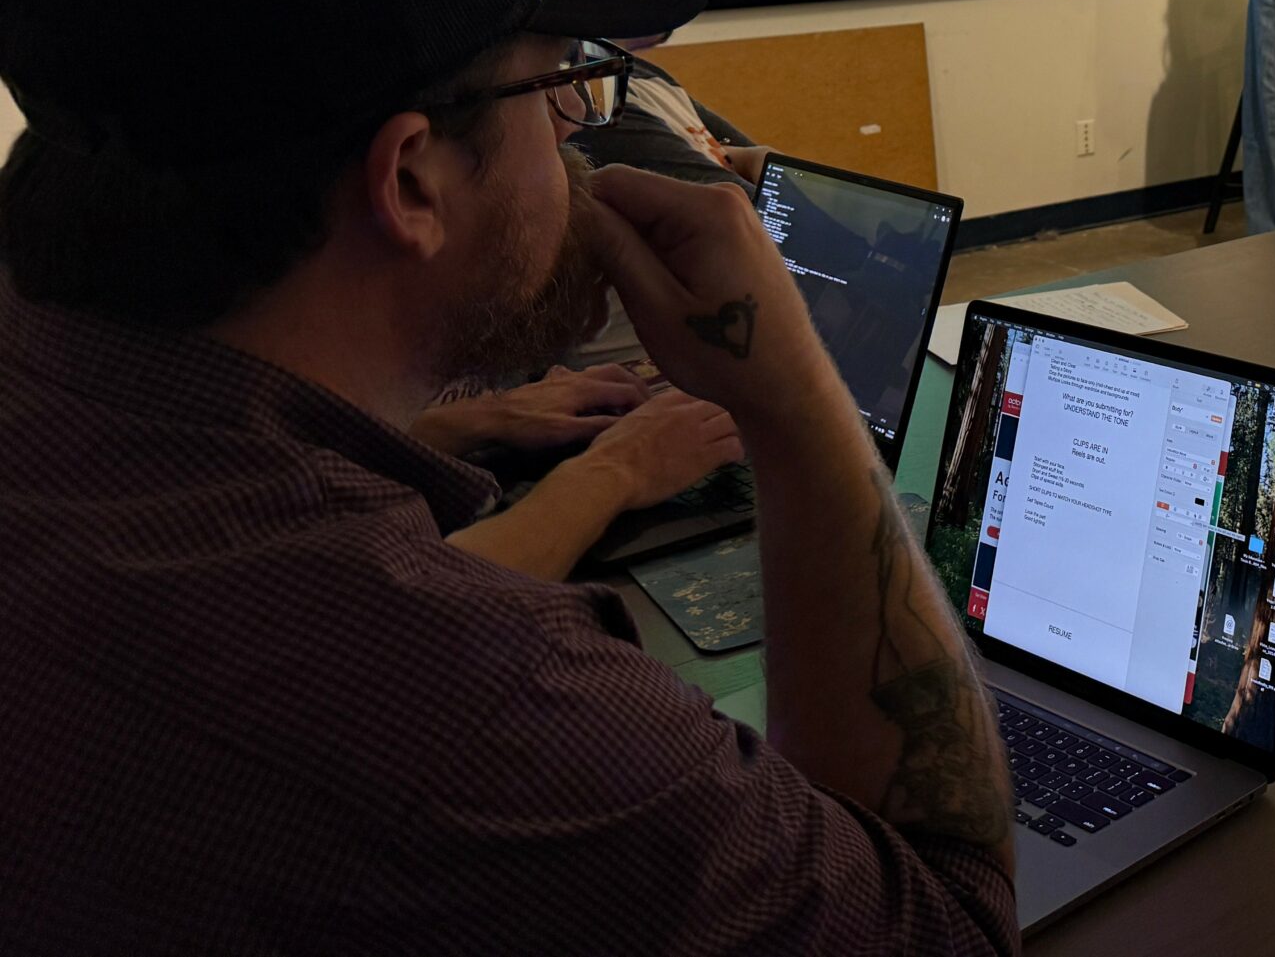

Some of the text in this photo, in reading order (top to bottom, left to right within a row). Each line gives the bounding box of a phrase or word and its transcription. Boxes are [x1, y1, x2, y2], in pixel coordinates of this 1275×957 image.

[1062, 393, 1075, 402] What
[1096, 403, 1122, 416] submitting
[1123, 409, 1134, 417] for?
[1064, 403, 1129, 427] UNDERSTAND THE TONE
[1072, 448, 1085, 458] Reels
[1073, 439, 1089, 448] CLIPS
[1090, 444, 1101, 452] ARE
[1048, 625, 1072, 640] RESUME
